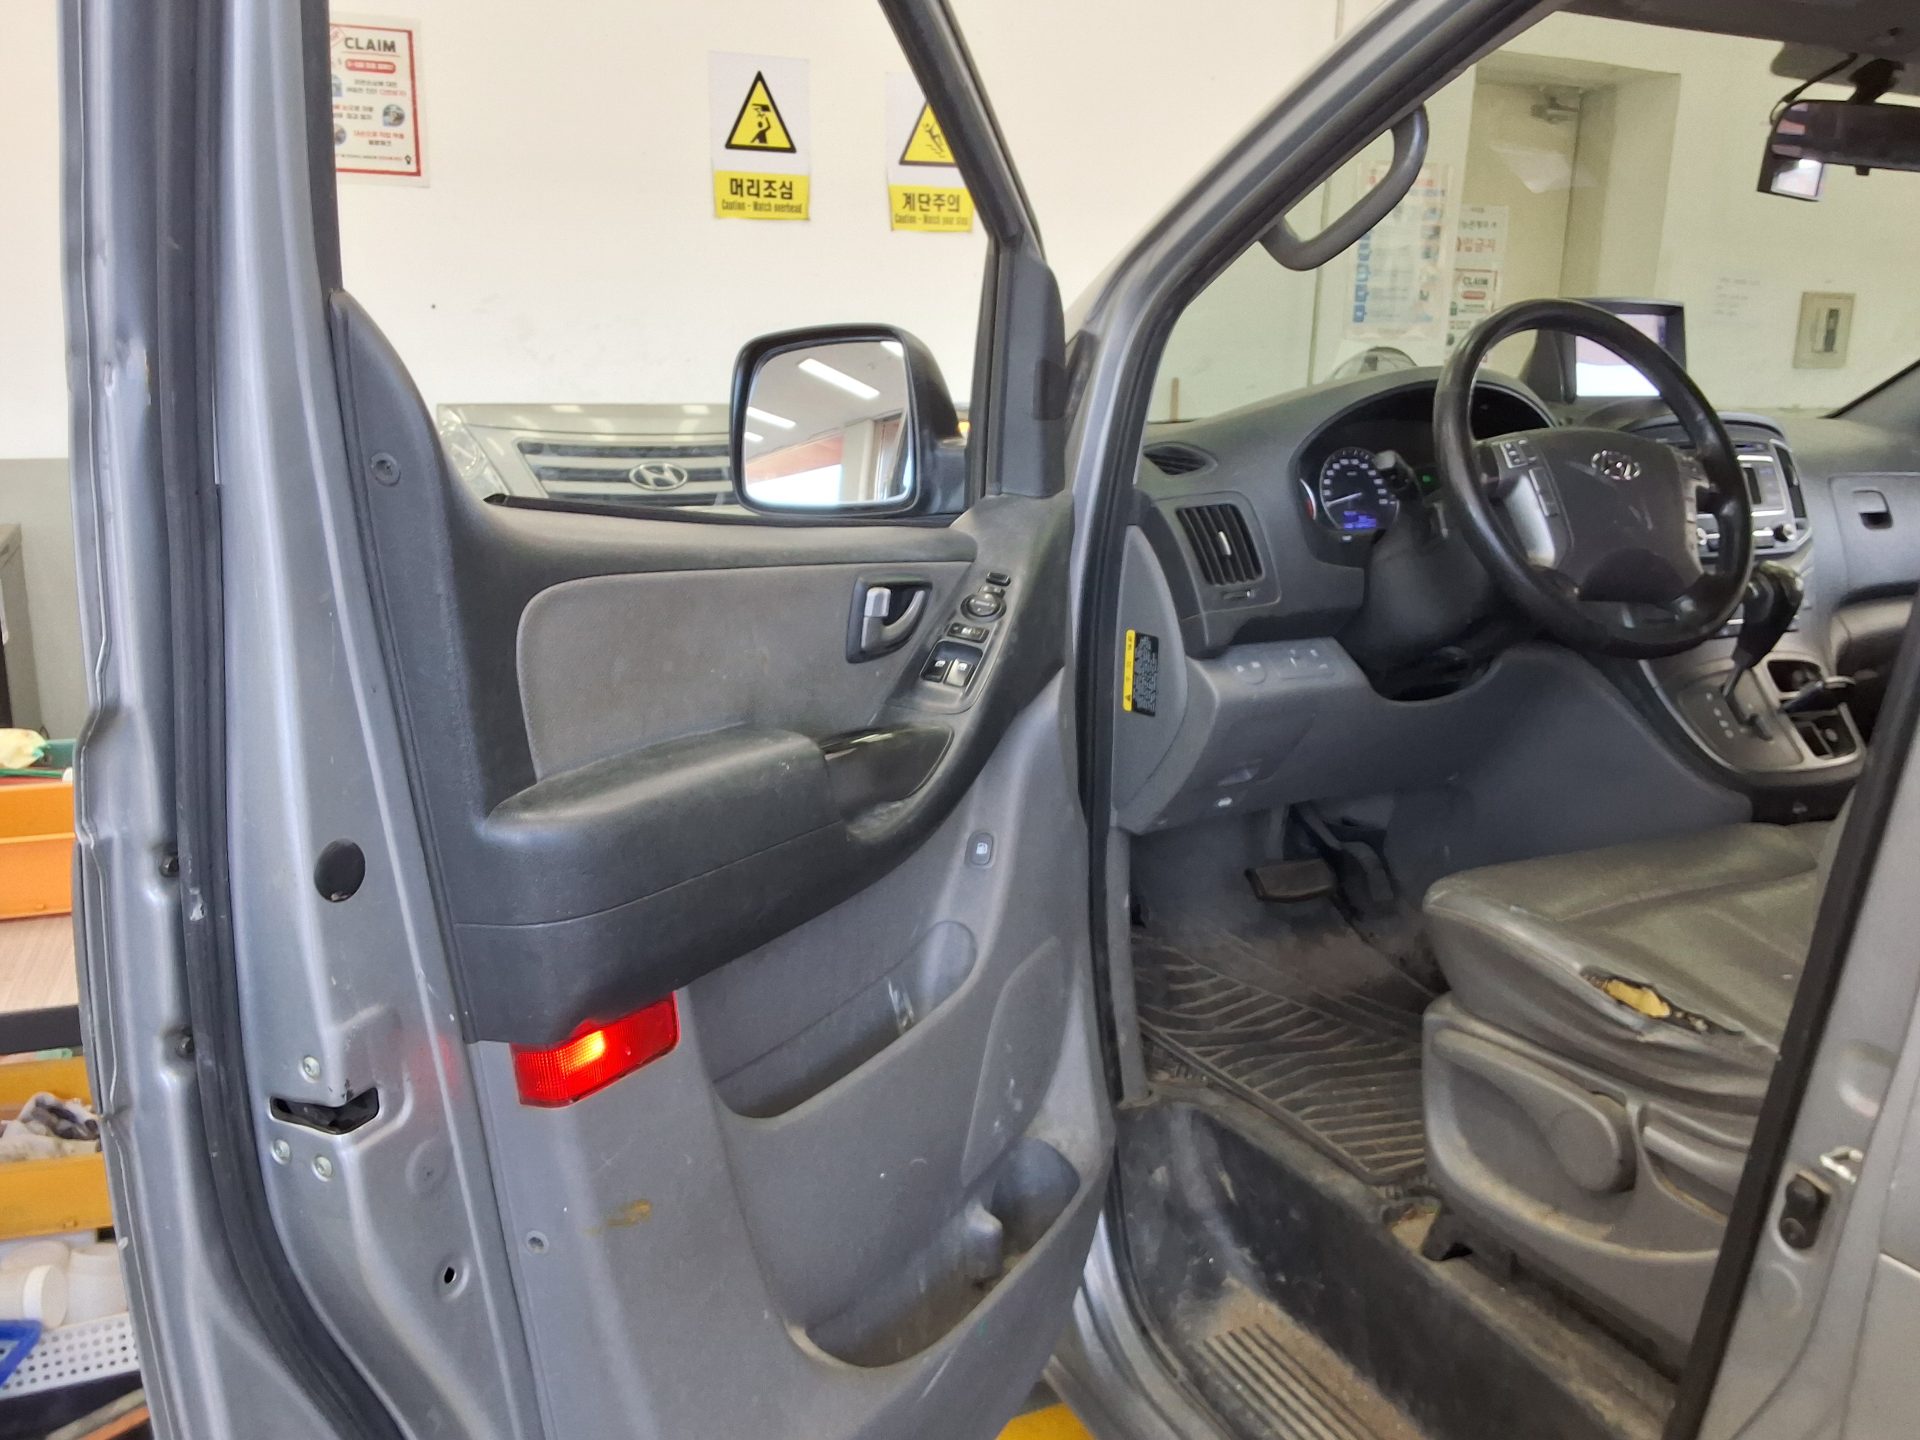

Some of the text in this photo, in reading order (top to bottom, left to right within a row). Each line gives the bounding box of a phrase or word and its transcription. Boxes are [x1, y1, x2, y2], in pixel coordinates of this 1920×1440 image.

[344, 37, 396, 53] CLAIM
[729, 178, 793, 200] 머리조심
[721, 199, 746, 211] Caution
[902, 192, 961, 213] 계단주의
